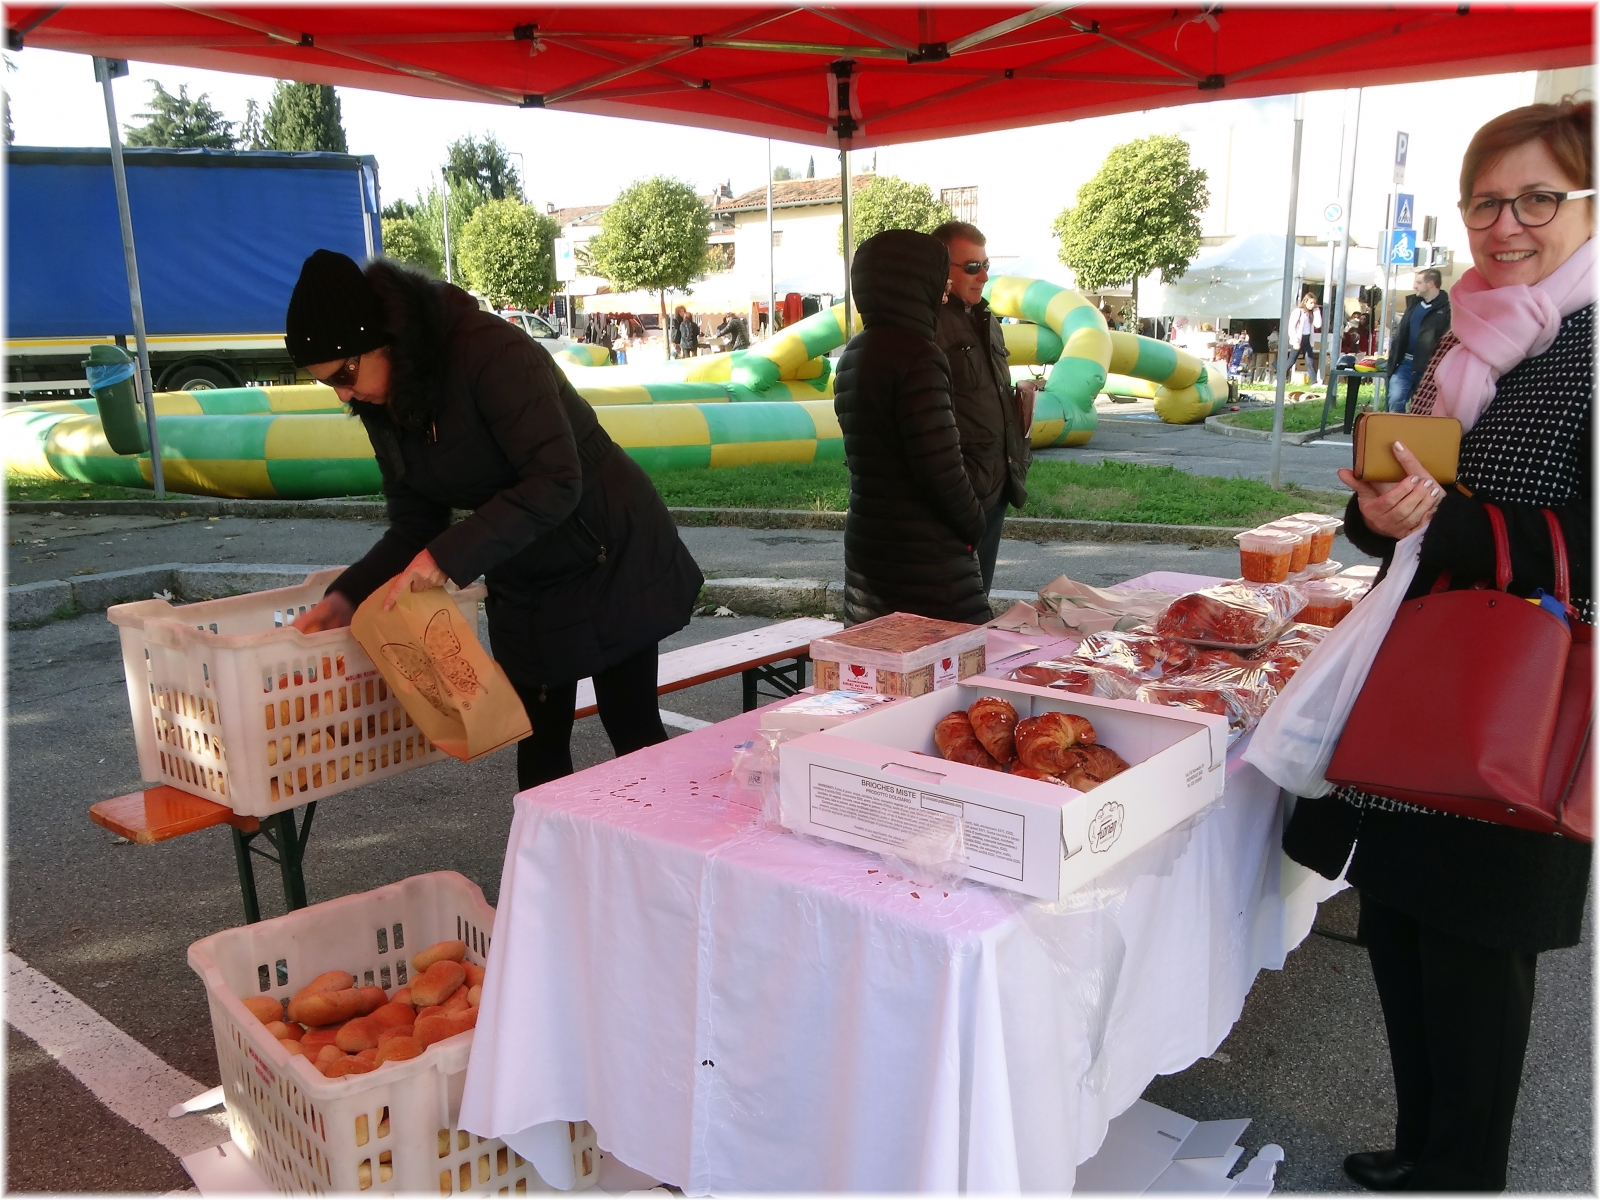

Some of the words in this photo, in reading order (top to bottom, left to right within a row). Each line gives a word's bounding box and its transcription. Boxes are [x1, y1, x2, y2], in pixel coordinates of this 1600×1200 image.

[1397, 134, 1407, 162] P
[861, 779, 895, 793] BRIOCHES
[895, 786, 916, 799] MISTE
[865, 788, 888, 798] PRODOTTO
[888, 793, 911, 803] DOLCIARIO
